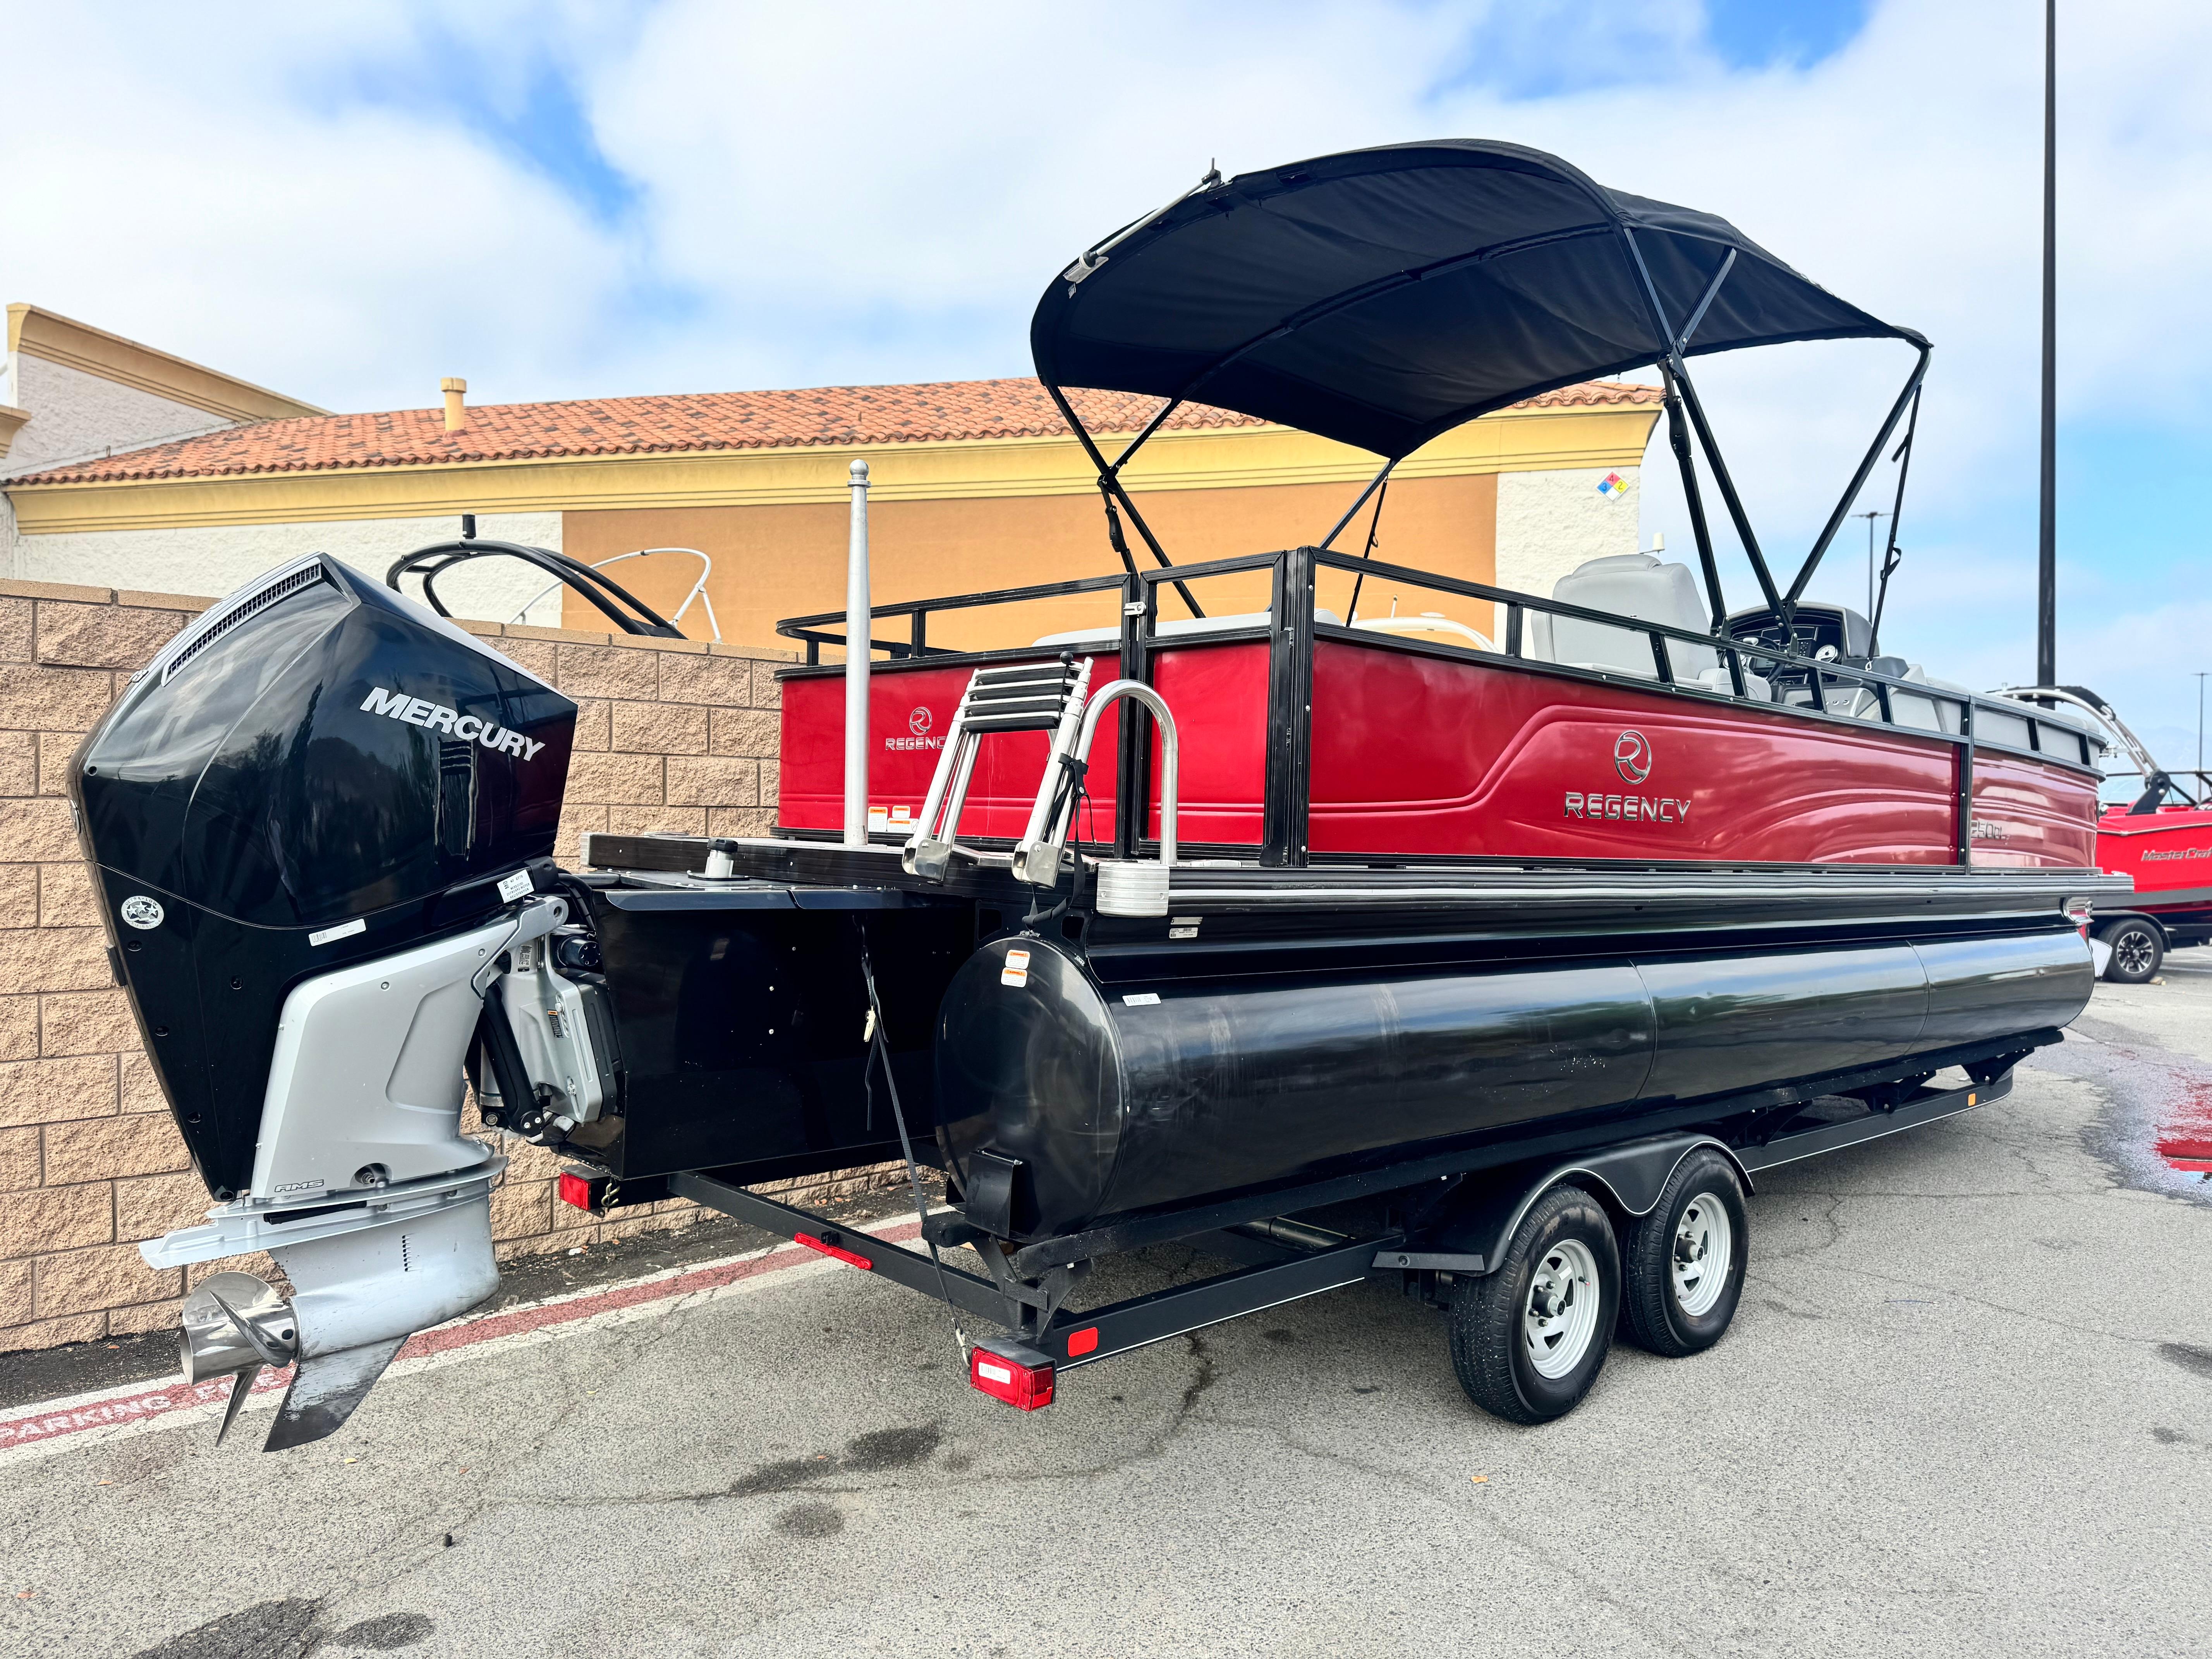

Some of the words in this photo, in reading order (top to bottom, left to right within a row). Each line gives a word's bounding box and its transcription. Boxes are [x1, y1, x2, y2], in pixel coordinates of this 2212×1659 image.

[1609, 474, 1614, 483] 4
[1602, 483, 1607, 491] 3
[1618, 481, 1623, 489] 2
[359, 687, 546, 761] MERCURY
[885, 736, 948, 750] REGENC
[1564, 791, 1691, 823] REGENCY
[2141, 846, 2212, 861] MasterCraf
[146, 898, 158, 906] LOW
[275, 1179, 324, 1192] AMS
